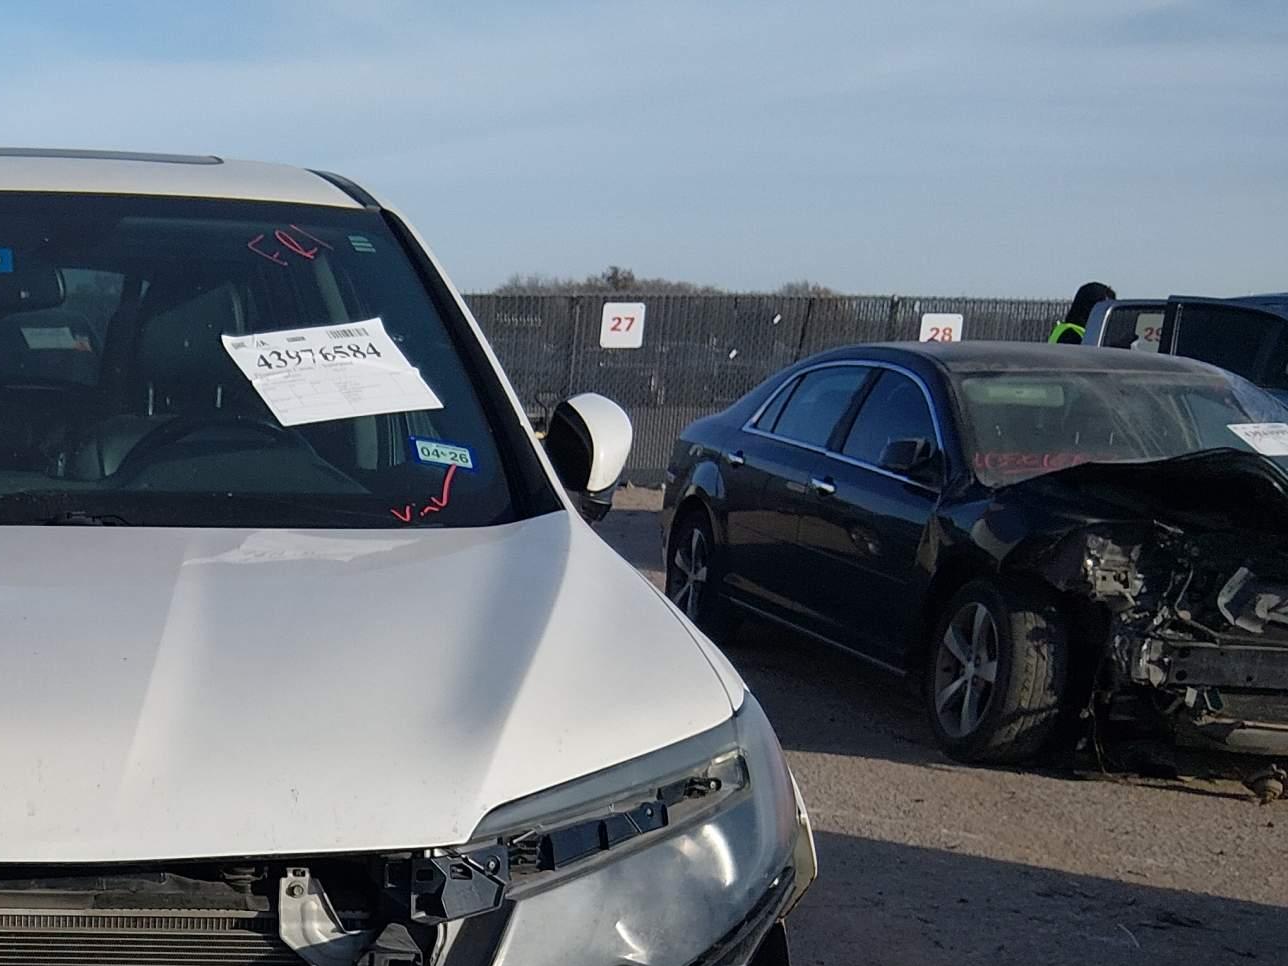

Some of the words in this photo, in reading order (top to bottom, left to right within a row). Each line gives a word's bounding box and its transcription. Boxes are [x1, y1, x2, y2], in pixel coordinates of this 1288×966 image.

[610, 316, 635, 332] 27
[927, 327, 953, 343] 28
[257, 341, 382, 370] 43976584
